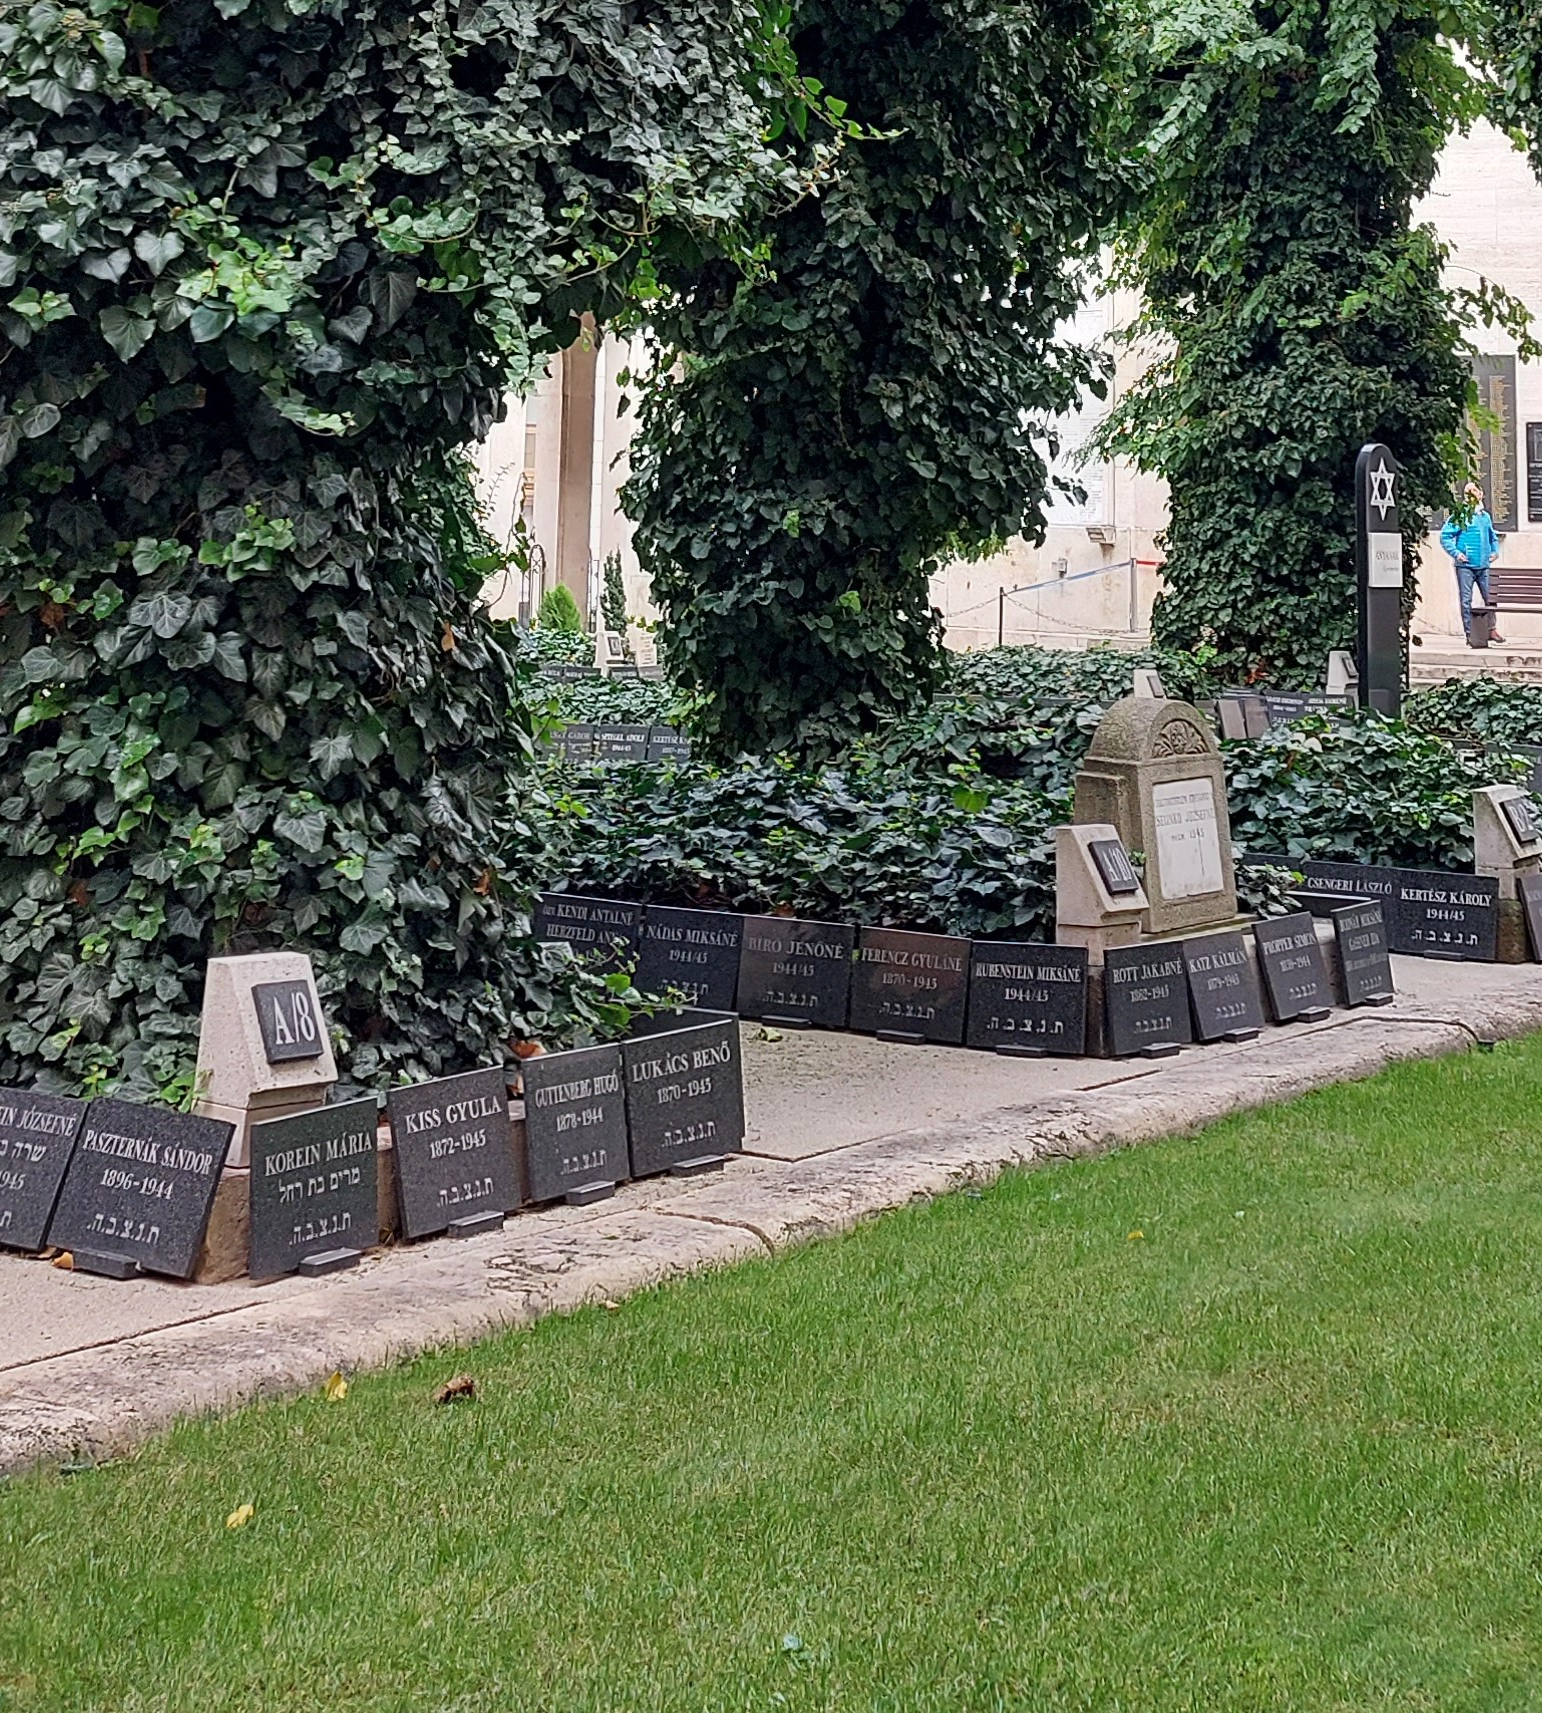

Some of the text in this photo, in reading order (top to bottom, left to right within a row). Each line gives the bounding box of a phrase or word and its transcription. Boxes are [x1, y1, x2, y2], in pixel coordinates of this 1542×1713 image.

[1400, 888, 1492, 907] KERTÉSZ KÁROLY
[1426, 908, 1465, 921] 1944/45
[647, 923, 739, 948] NÁDAS MIKSÁNÉ
[668, 949, 708, 964] 1944/45
[861, 947, 963, 972] FERENCZ GYULÁNÉ
[1188, 957, 1210, 973] KATZ
[771, 961, 815, 978] 1944/45
[975, 962, 1082, 983] RUBENSTEIN MIKSÁNÉ
[1113, 966, 1139, 984] ROTT
[1004, 987, 1049, 1003] 1944/45
[273, 991, 316, 1045] A/8
[633, 1040, 731, 1084] LUKÁCS BENŐ
[535, 1068, 618, 1108] GUTTENBERG HUGÓ
[16, 1105, 78, 1138] JÓZSEFNÉ
[405, 1095, 502, 1135] KISS GYULA
[12, 1141, 46, 1163] שרה
[82, 1129, 213, 1175] PASZTERNÁK SÁNDOR
[264, 1131, 373, 1177] KOREIN MÁRIA
[429, 1129, 486, 1159] 1872-1945
[100, 1168, 173, 1200] 1896-1944
[279, 1167, 360, 1204] מרים בת רחל
